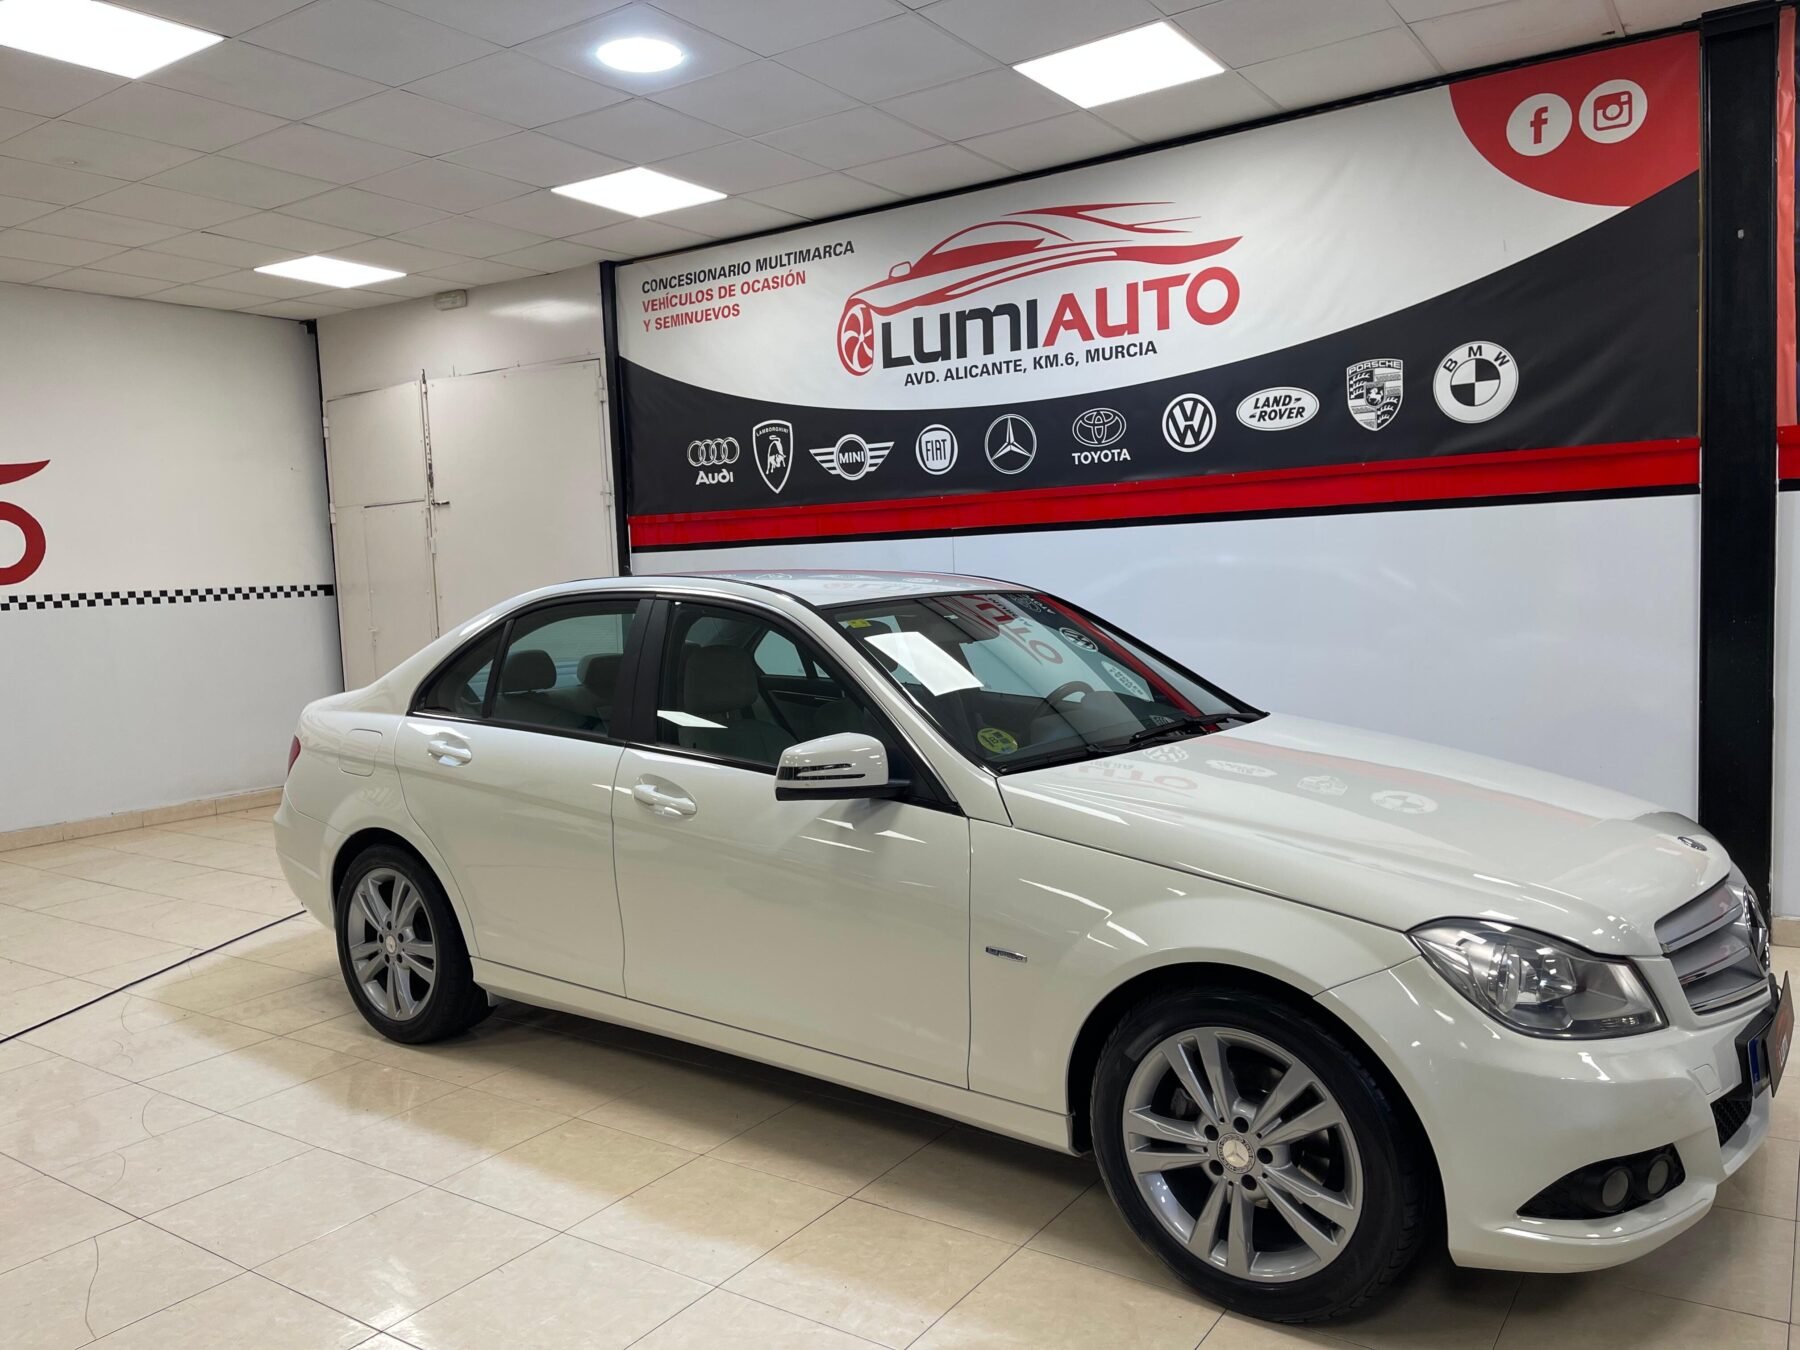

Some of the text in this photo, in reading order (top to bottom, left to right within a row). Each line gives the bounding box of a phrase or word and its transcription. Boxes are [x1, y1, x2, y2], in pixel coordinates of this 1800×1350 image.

[641, 240, 855, 294] CONCESIONARIO MULTIMARCA
[642, 269, 806, 313] VEHÍCULOS DE OCASIÓN
[643, 303, 741, 333] Y SEMINUEVOS
[904, 340, 1158, 387] AVD. ALICANTE, KM.6, MURCIA
[1349, 360, 1401, 375] PORSCHE
[755, 426, 789, 437] LAMBORGHINI
[838, 450, 865, 465] MINI
[925, 438, 947, 461] FIAT
[1072, 449, 1131, 465] TOYOTA
[695, 468, 734, 486] Audi
